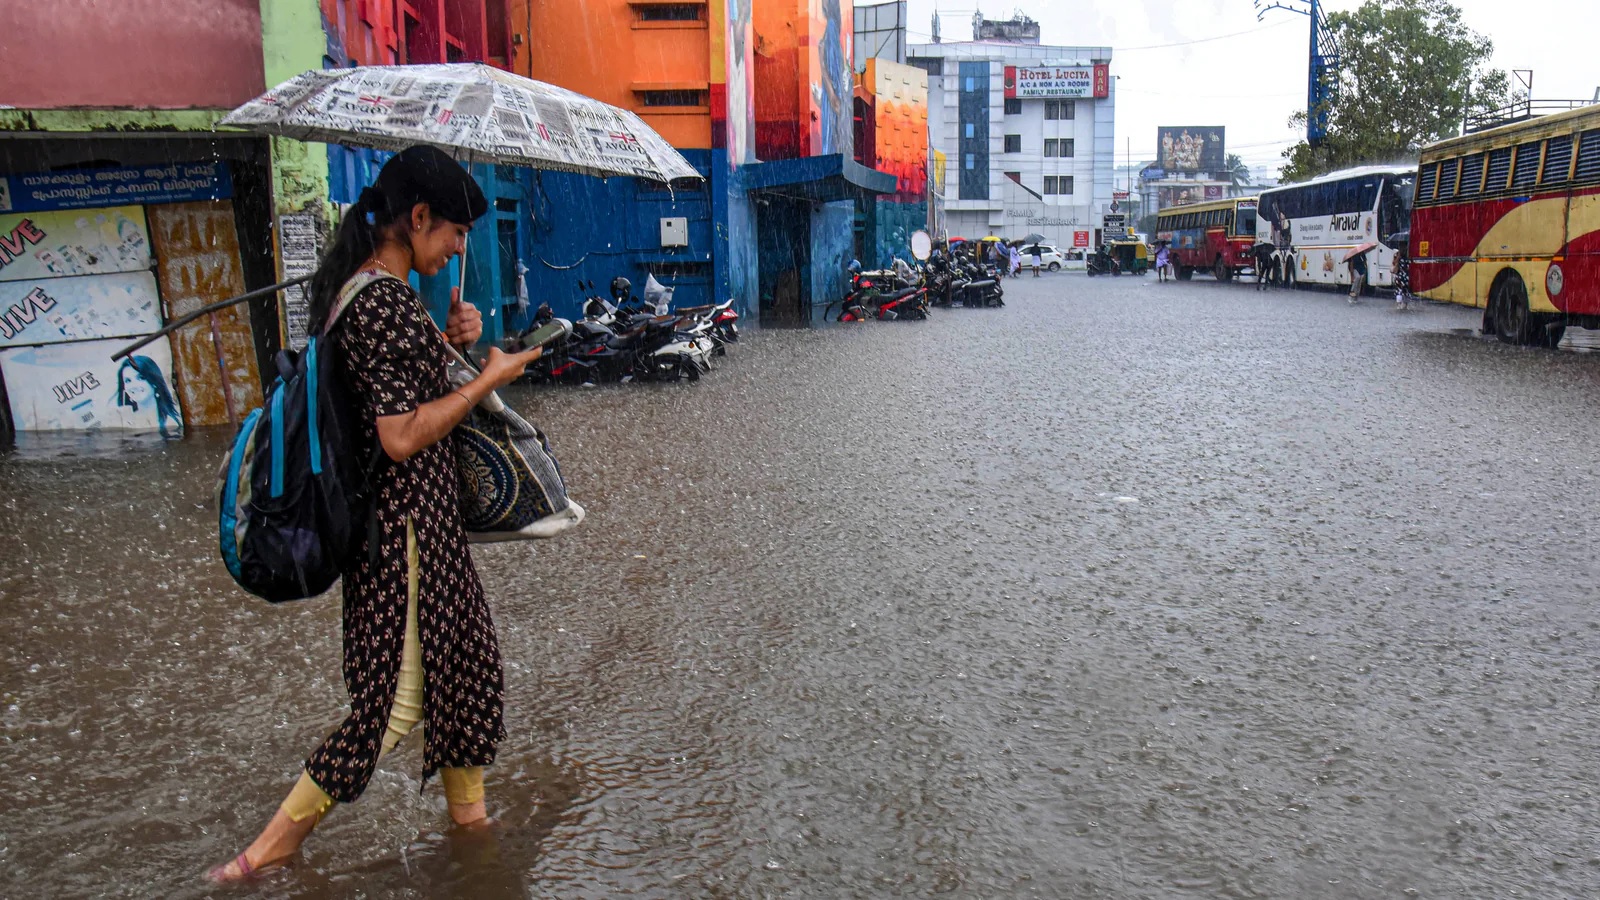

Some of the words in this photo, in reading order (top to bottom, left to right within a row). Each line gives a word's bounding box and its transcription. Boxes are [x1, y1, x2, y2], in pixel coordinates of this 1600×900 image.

[1007, 209, 1036, 218] FAMILY
[1026, 217, 1080, 226] RESTAURANT
[1329, 211, 1361, 232] Airavat
[0, 217, 47, 270] IVE
[0, 286, 58, 340] JIVE
[52, 371, 101, 404] JIVE
